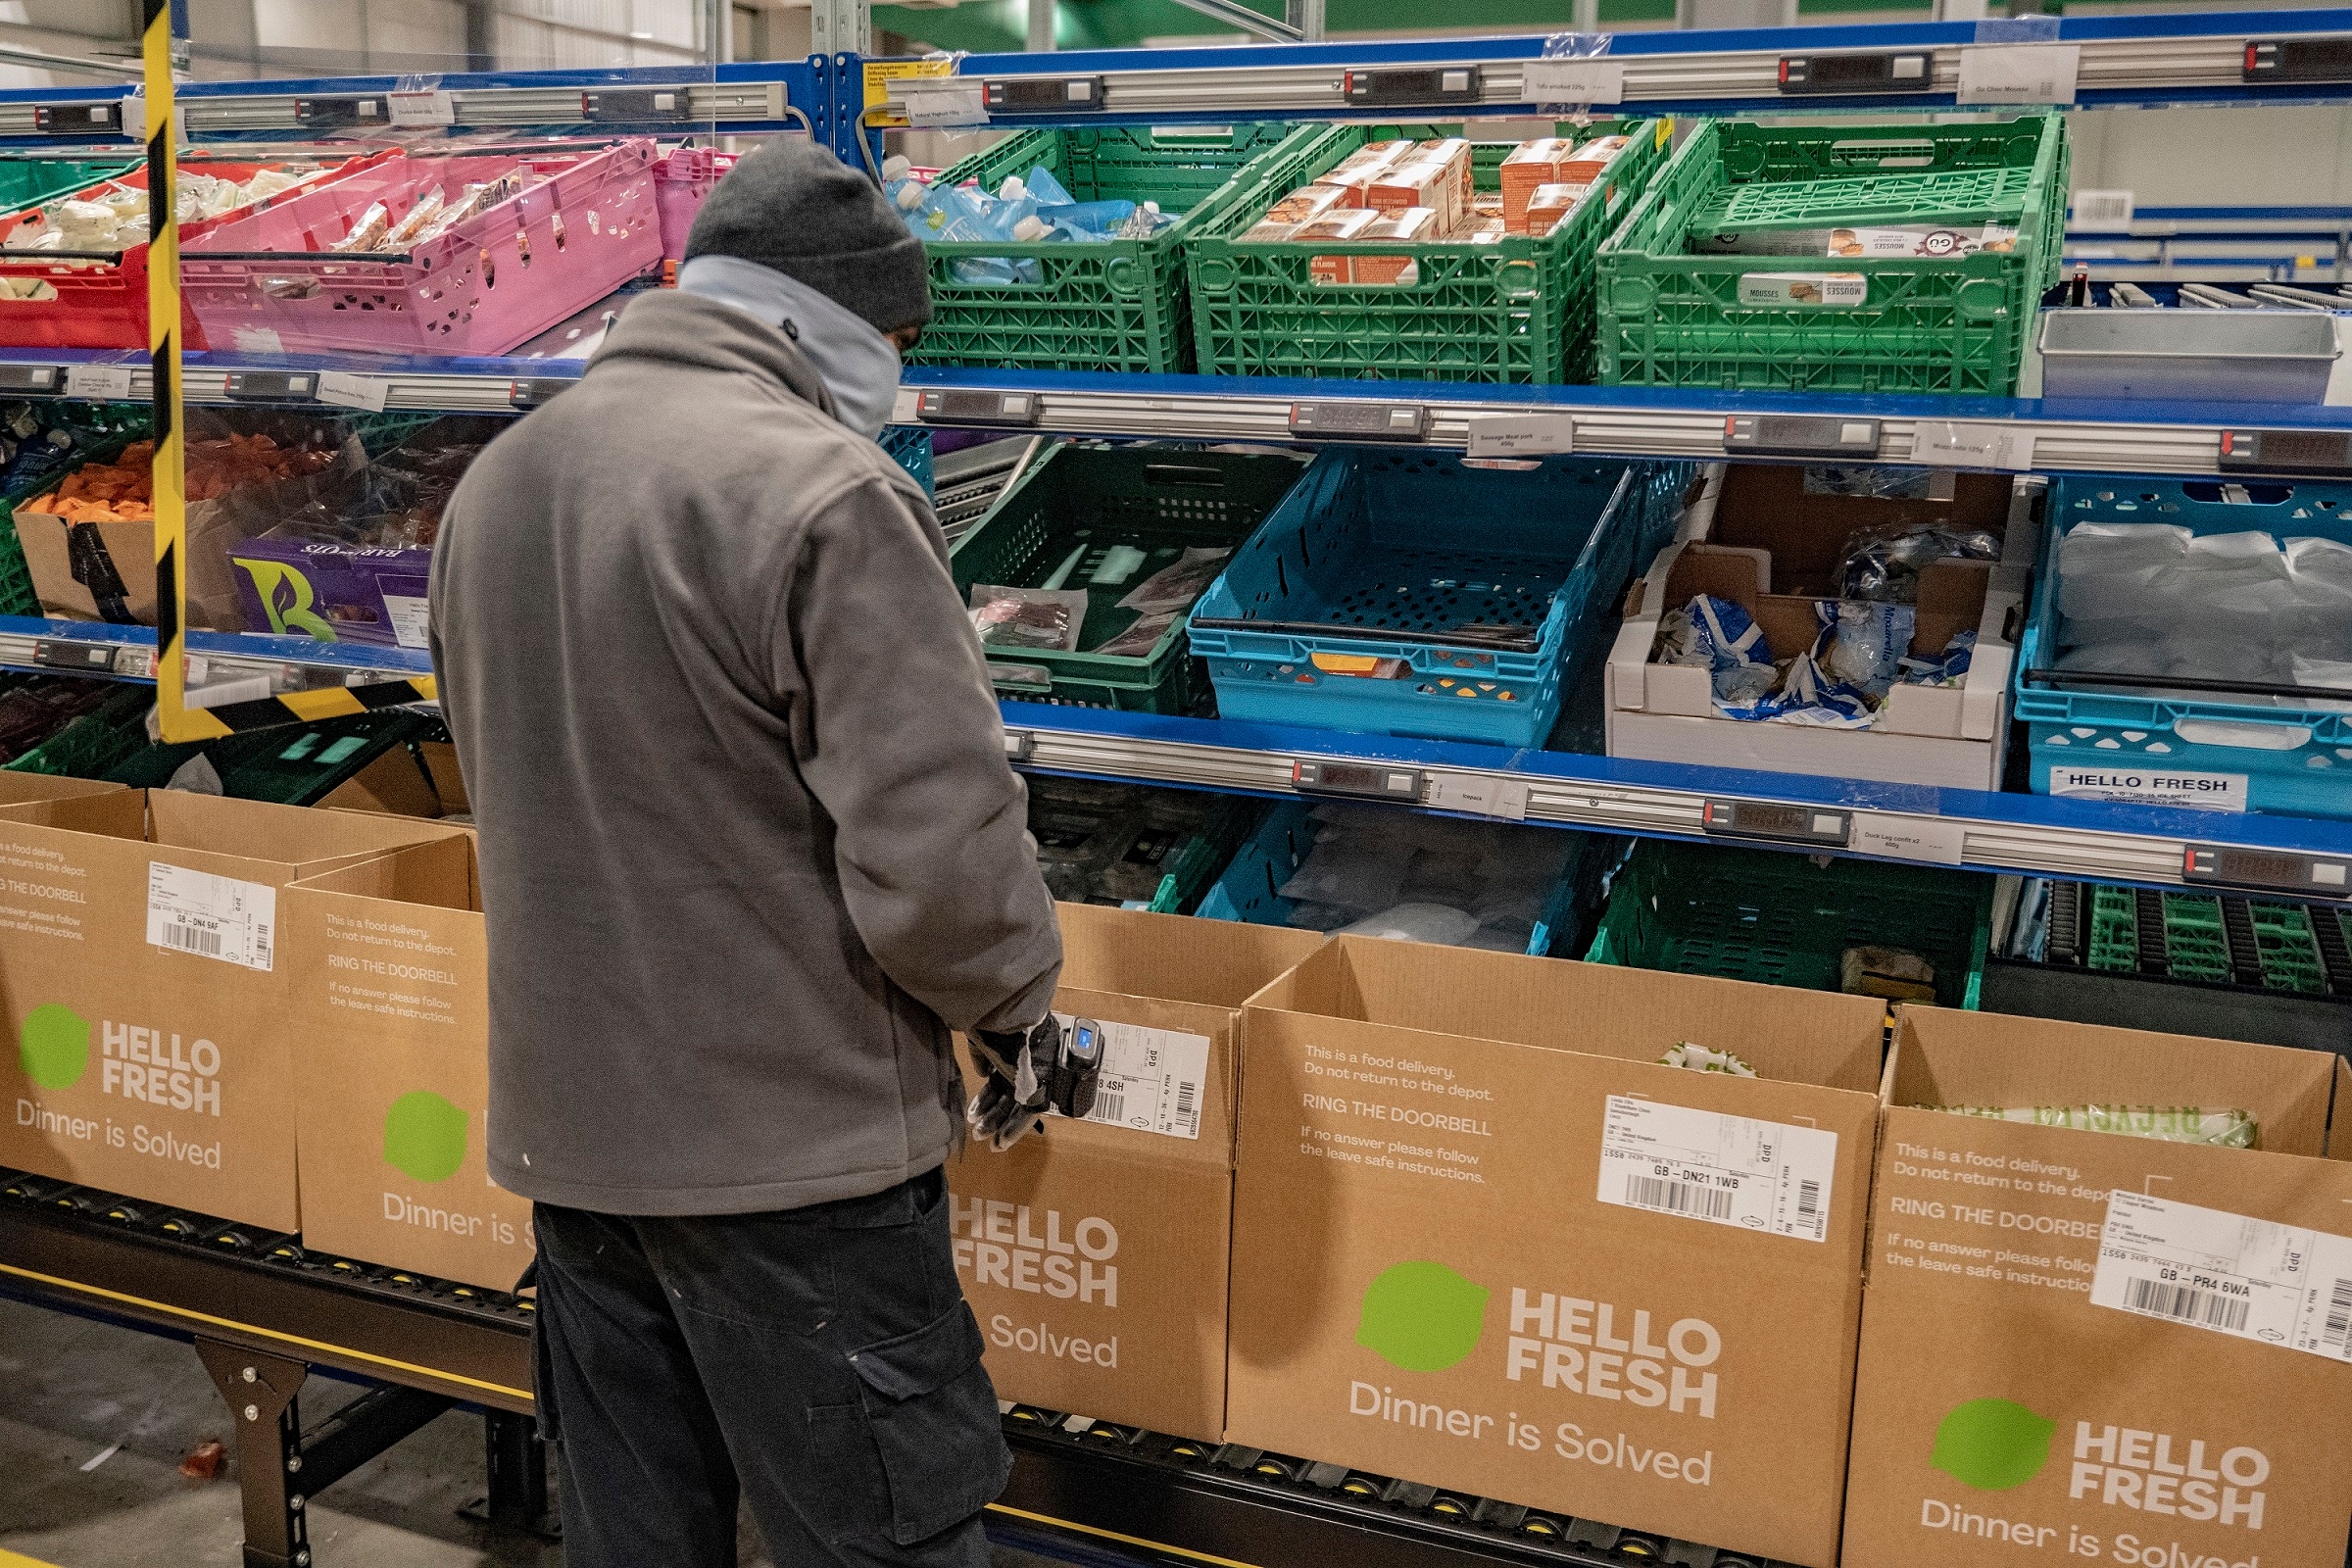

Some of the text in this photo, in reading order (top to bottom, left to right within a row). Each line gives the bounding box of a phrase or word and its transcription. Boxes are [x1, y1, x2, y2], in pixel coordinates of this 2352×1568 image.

[1750, 289, 1779, 298] MOUSSES
[1827, 286, 1861, 295] MOUSSES
[301, 545, 404, 557] BAROTS
[2070, 774, 2227, 792] HELLO FRESH
[6, 858, 87, 878] return to the depot.
[13, 843, 30, 856] food
[31, 847, 66, 862] delivery.
[9, 880, 27, 894] THE
[29, 884, 86, 904] DOORBELL
[18, 920, 33, 933] safe
[34, 923, 84, 941] instructions.
[29, 909, 54, 922] please
[56, 913, 80, 926] follow
[177, 914, 186, 923] GB
[326, 913, 344, 925] This
[347, 916, 355, 927] is
[365, 919, 386, 931] food
[390, 923, 429, 940] delivery.
[326, 928, 457, 956] Do not return to the depot.
[328, 955, 458, 986] RING THE DOORBELL
[329, 981, 452, 1009] If no answer please follow
[330, 996, 457, 1024] the leave safe instructions.
[102, 1020, 220, 1076] HELLO
[1149, 1050, 1157, 1067] DPD
[1305, 1045, 1455, 1081] This is a food delivery.
[102, 1057, 220, 1117] FRESH
[1106, 1080, 1124, 1092] 4SH
[1304, 1062, 1494, 1102] Do not return to the depot.
[1303, 1094, 1492, 1137] RING THE DOORBELL
[16, 1098, 220, 1169] Dinner is Solved
[1300, 1126, 1479, 1164] If no answer please follow
[1300, 1143, 1486, 1184] the leave safe instructions.
[1761, 1145, 1772, 1162] DPD
[1896, 1143, 2081, 1181] This is a food delivery.
[1655, 1165, 1739, 1189] GB DN21 1WB
[1893, 1162, 1917, 1176] Do
[1921, 1166, 1949, 1181] not
[1954, 1172, 2009, 1188] return
[2013, 1179, 2033, 1192] to
[2038, 1181, 2067, 1196] the
[383, 1192, 482, 1237] Dinner
[491, 1213, 515, 1245] is
[949, 1194, 1118, 1260] HELLO
[1890, 1197, 1945, 1219] RING
[1951, 1204, 1993, 1225] THE
[1999, 1211, 2100, 1240] DOORBE
[1886, 1252, 1914, 1266] the
[1919, 1256, 1961, 1272] leave
[1966, 1264, 2003, 1280] safe
[1887, 1233, 1899, 1245] If
[1904, 1237, 1924, 1250] no
[1929, 1240, 1991, 1258] answer
[1994, 1249, 2050, 1267] please
[2288, 1252, 2301, 1272] DPD
[951, 1238, 1117, 1307] FRESH
[2160, 1268, 2250, 1297] GB PR4 6WA
[990, 1314, 1117, 1368] Solved
[1510, 1287, 1721, 1366] HELLO
[1506, 1336, 1718, 1419] FRESH
[1349, 1380, 1712, 1486] Dinner is Solved
[2074, 1421, 2271, 1487] HELLO
[2069, 1461, 2266, 1531] FRESH
[1920, 1497, 2058, 1547] Dinner
[2069, 1525, 2100, 1557] is
